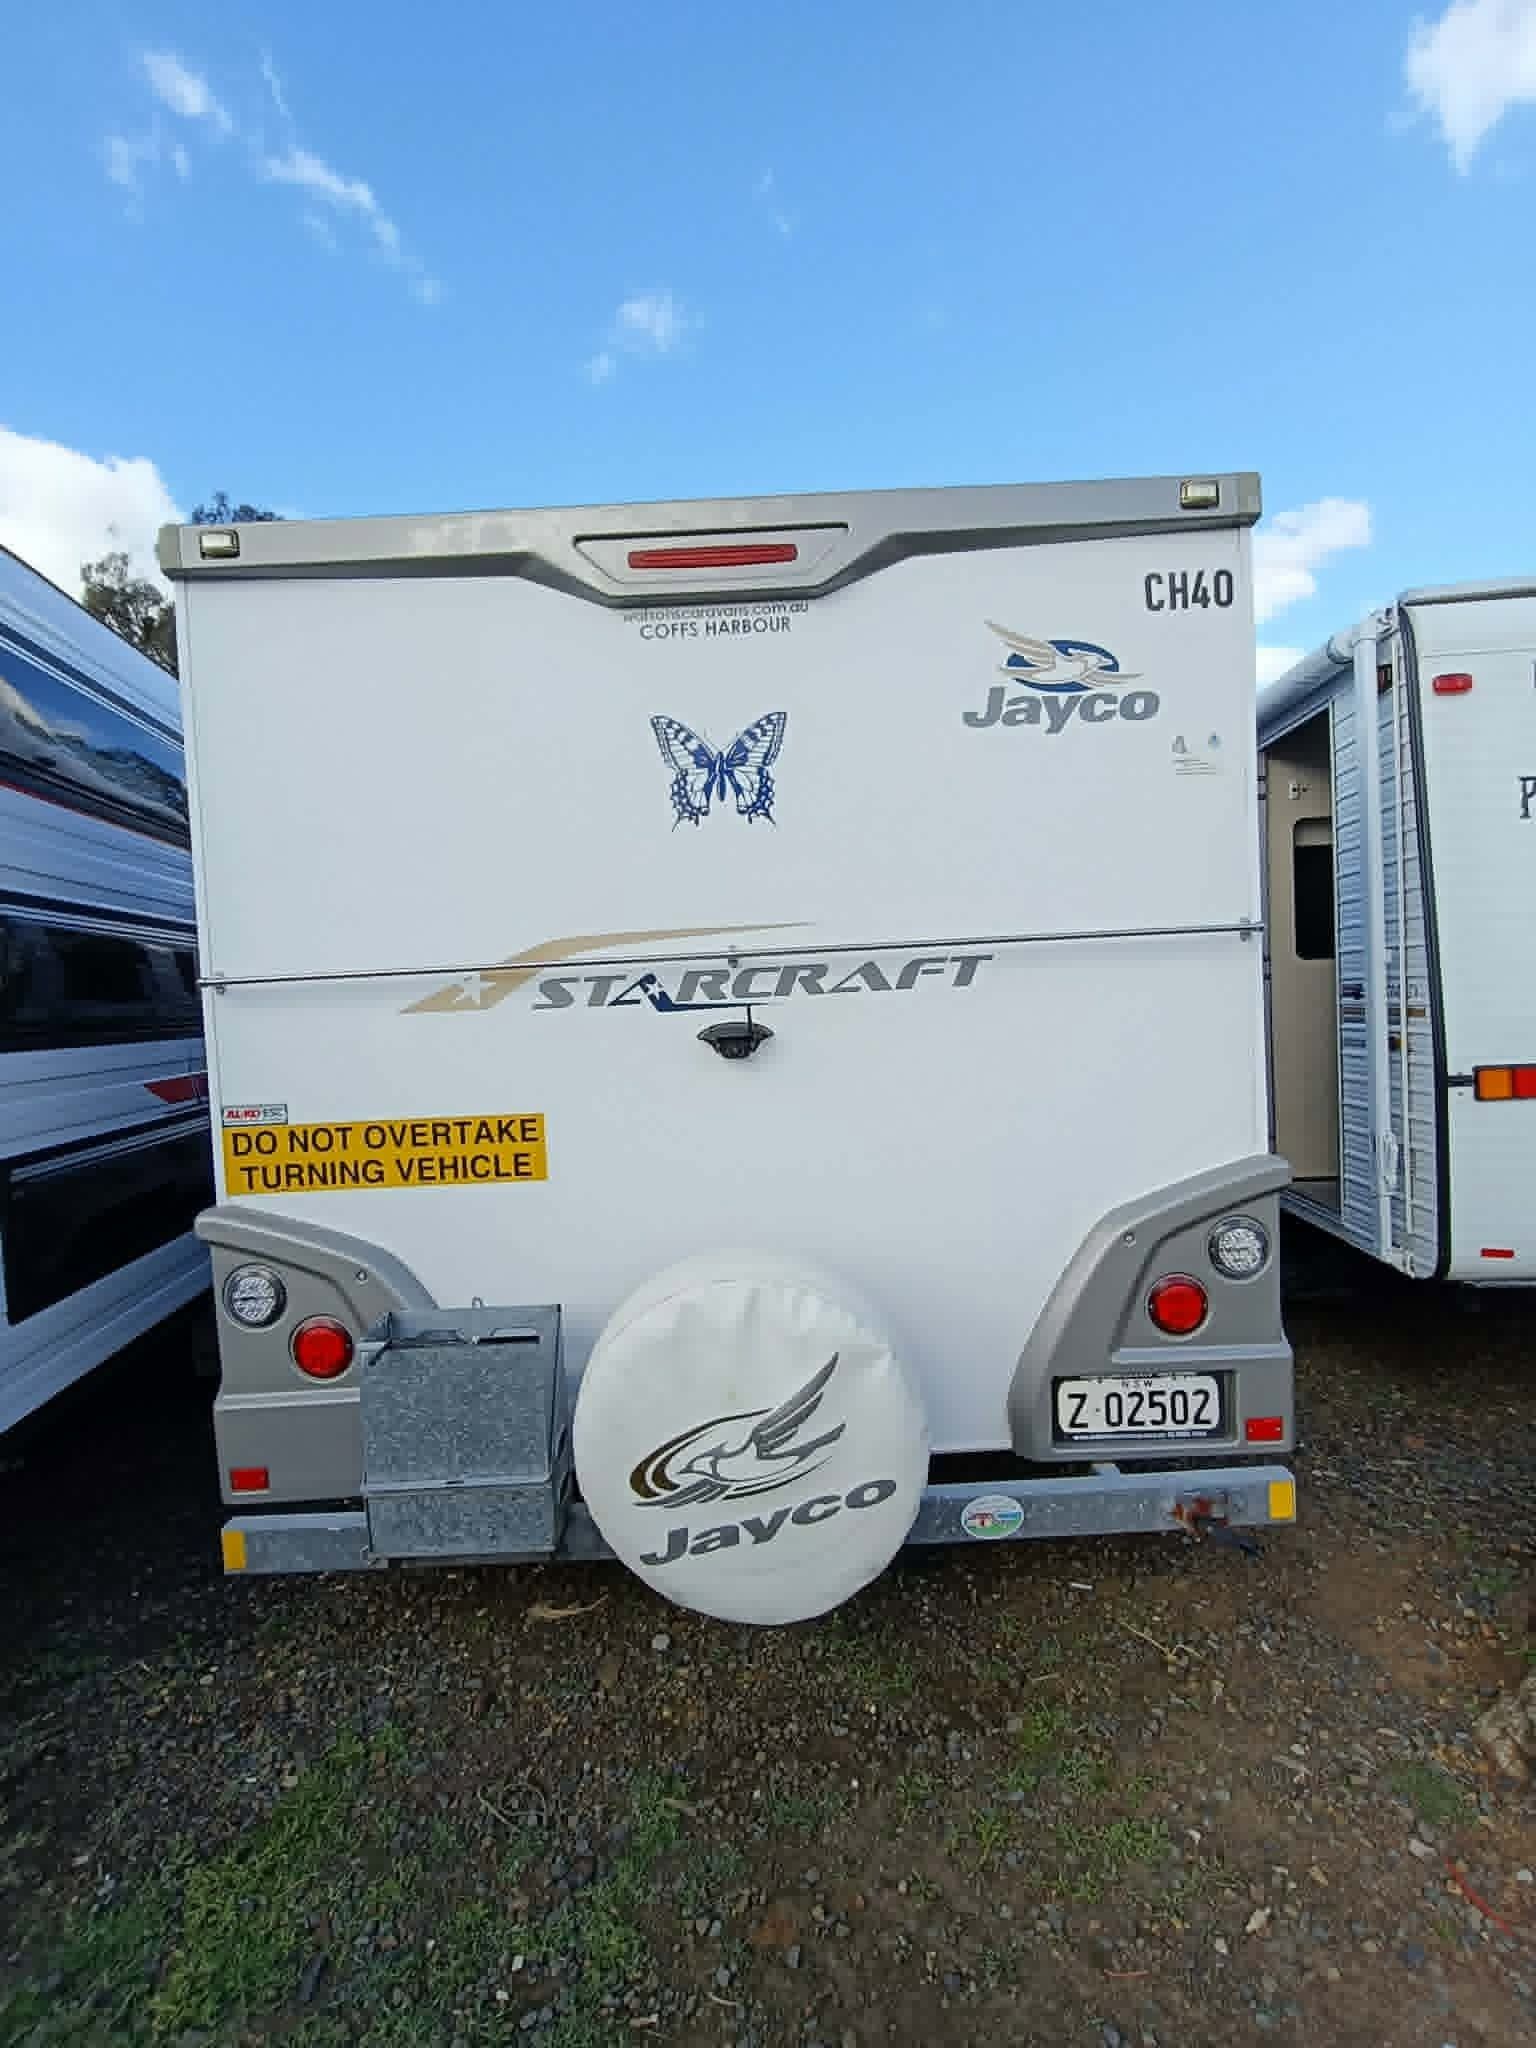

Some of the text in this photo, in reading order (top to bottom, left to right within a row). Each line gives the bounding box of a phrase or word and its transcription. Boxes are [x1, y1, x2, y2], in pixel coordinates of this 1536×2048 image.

[1144, 569, 1234, 612] CH40
[640, 615, 793, 640] COFFS HARBOUR
[962, 686, 1161, 734] Jayco
[531, 953, 994, 1012] STARCRAFT
[231, 1117, 542, 1157] DO NOT OVERTAKE
[239, 1151, 534, 1192] TURNING VEHICLE
[638, 1479, 897, 1566] Jayco
